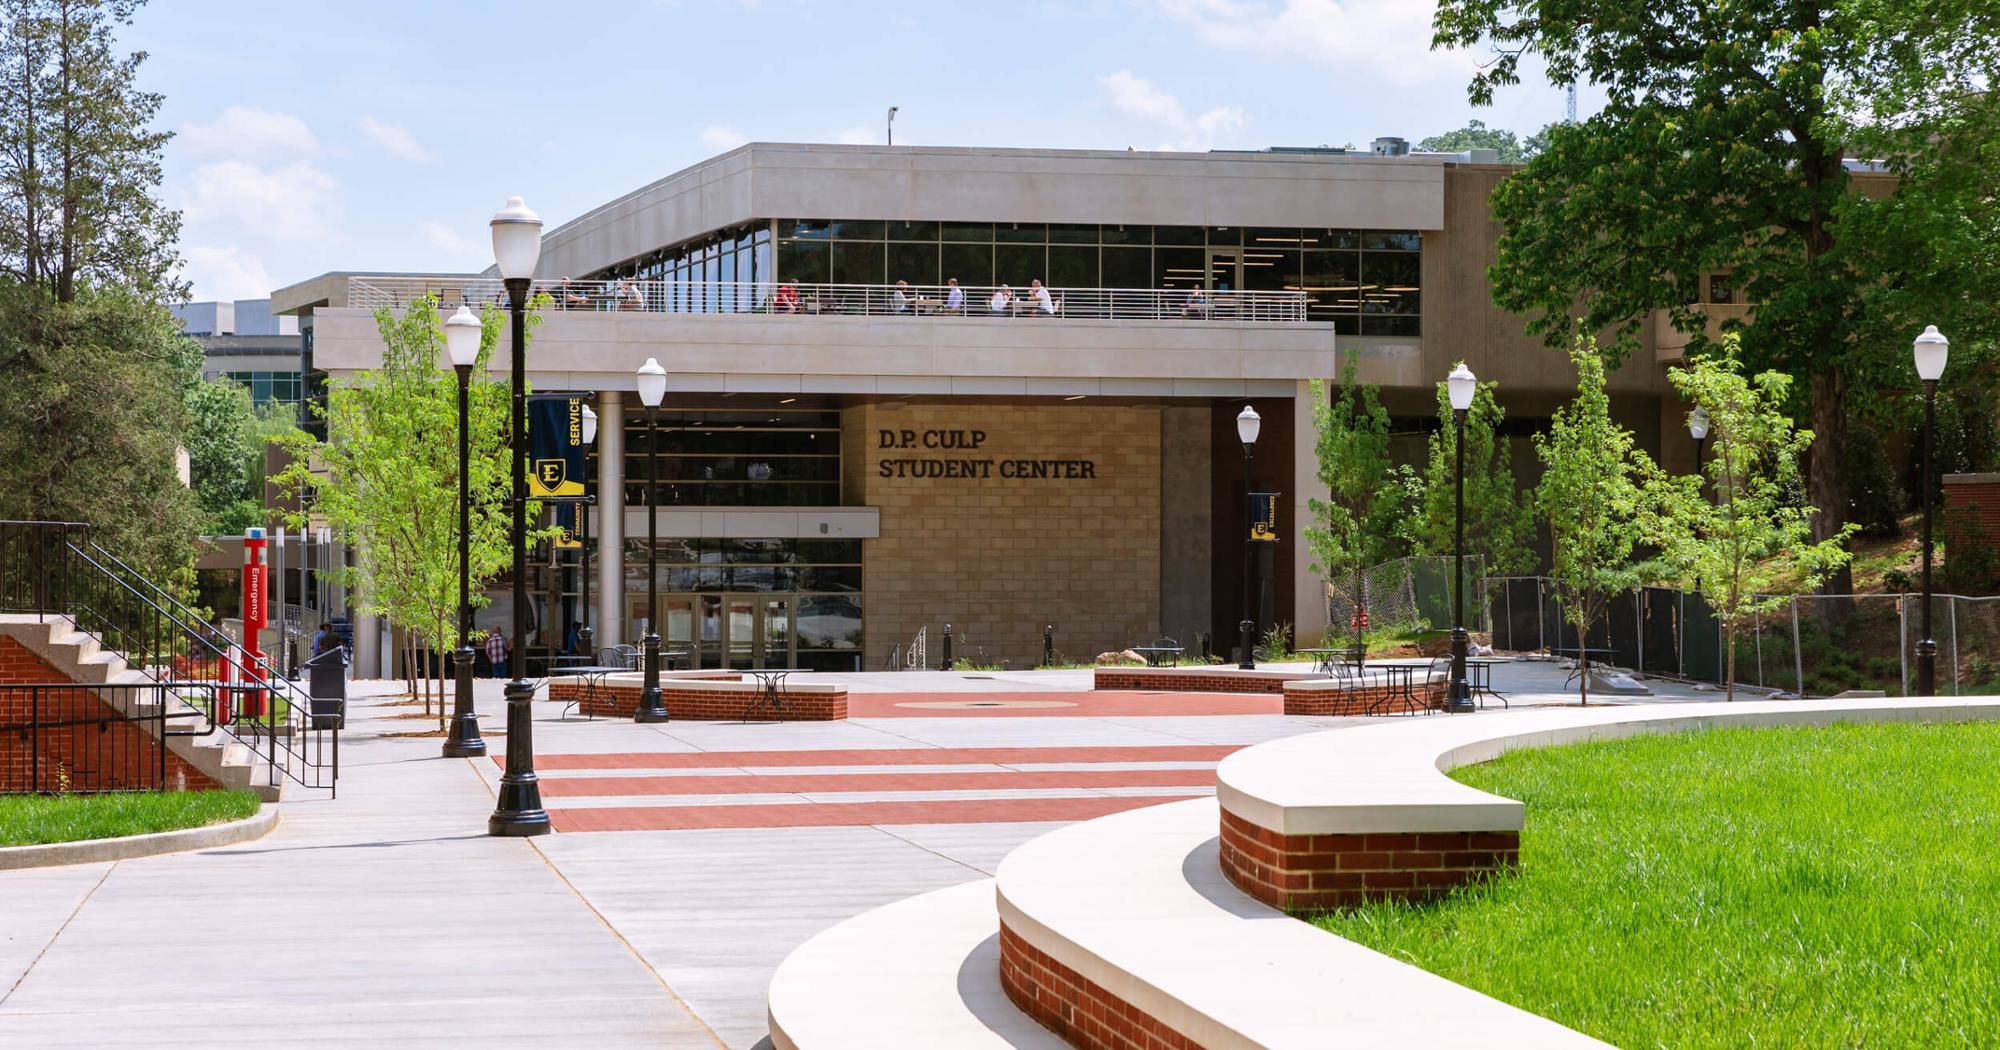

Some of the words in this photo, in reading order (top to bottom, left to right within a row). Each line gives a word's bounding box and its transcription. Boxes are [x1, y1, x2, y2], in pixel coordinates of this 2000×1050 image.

[570, 398, 580, 446] SERVICE
[879, 430, 916, 449] D.P.
[923, 430, 986, 449] CULP
[543, 464, 559, 482] E
[879, 459, 994, 478] STUDENT
[1000, 460, 1096, 479] CENTER
[250, 568, 260, 621] Emergency
